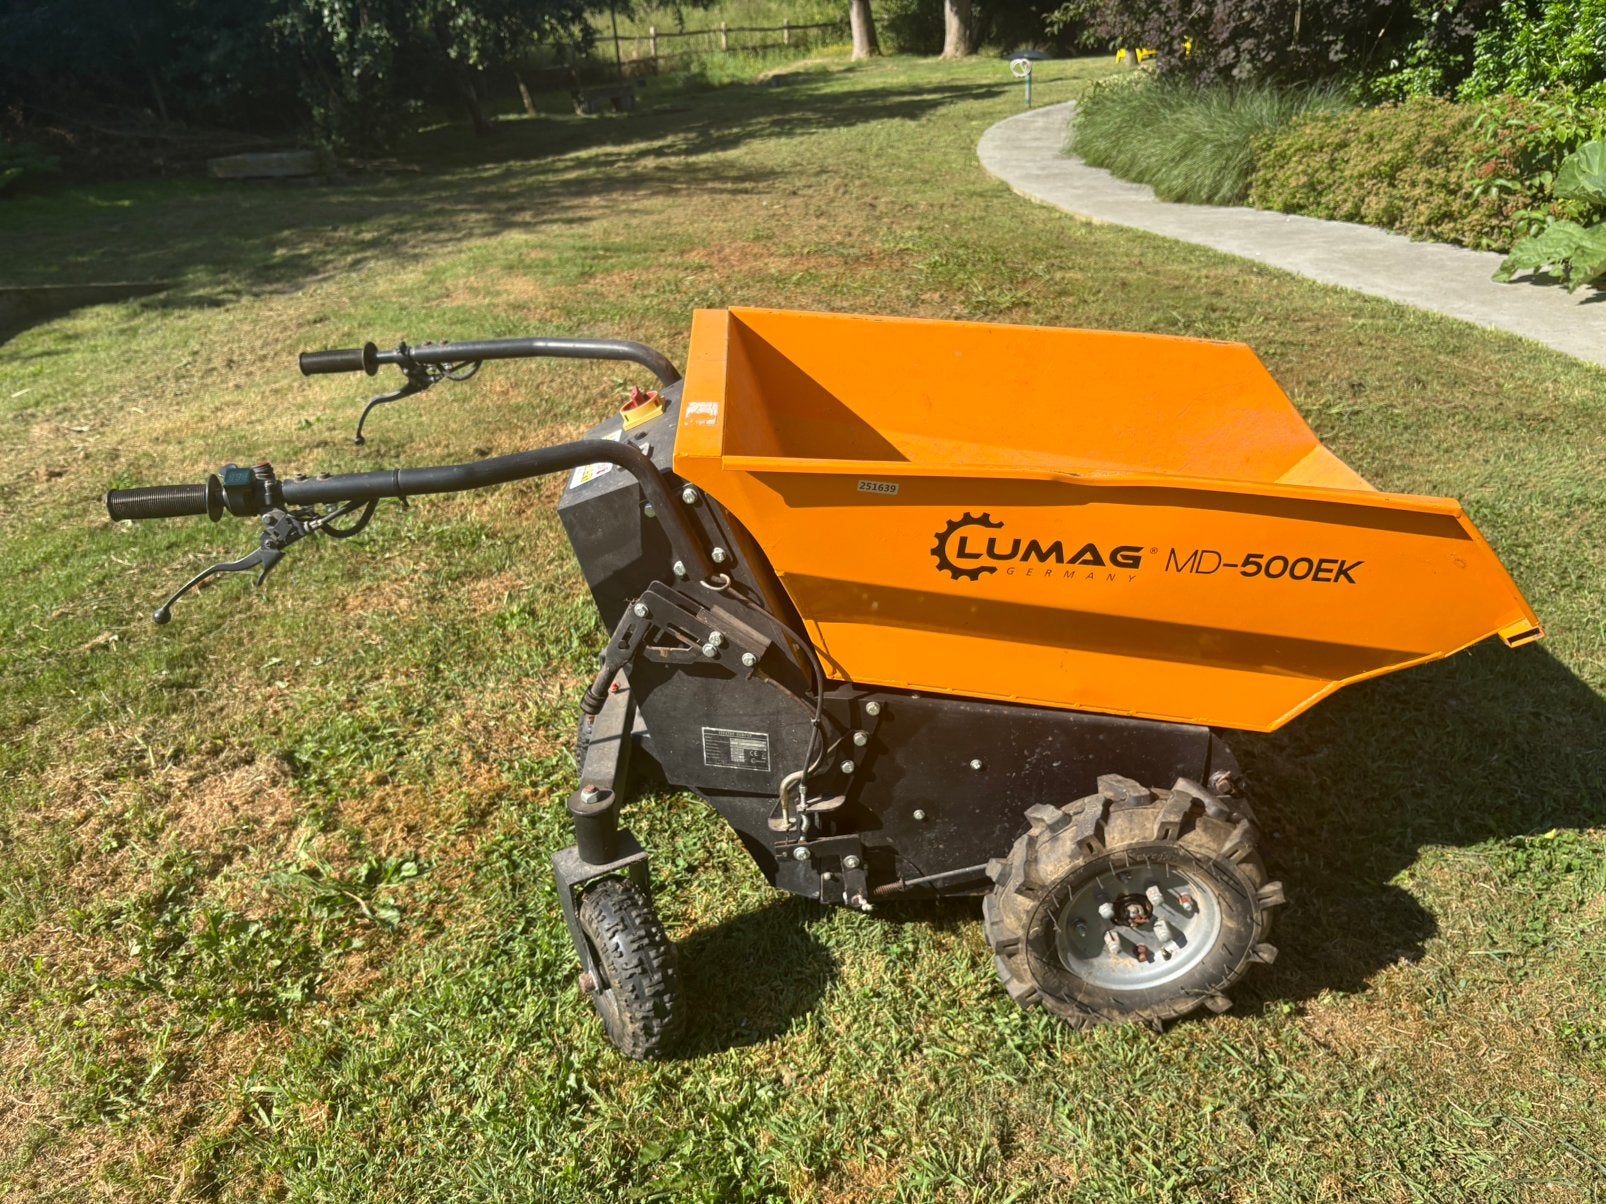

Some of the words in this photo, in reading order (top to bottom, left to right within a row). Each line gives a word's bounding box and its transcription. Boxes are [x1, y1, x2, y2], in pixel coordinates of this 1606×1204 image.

[859, 481, 896, 493] 251639
[956, 536, 1145, 570] LUMAG
[1165, 547, 1365, 584] MD-500EK
[1006, 567, 1136, 583] GERMANY
